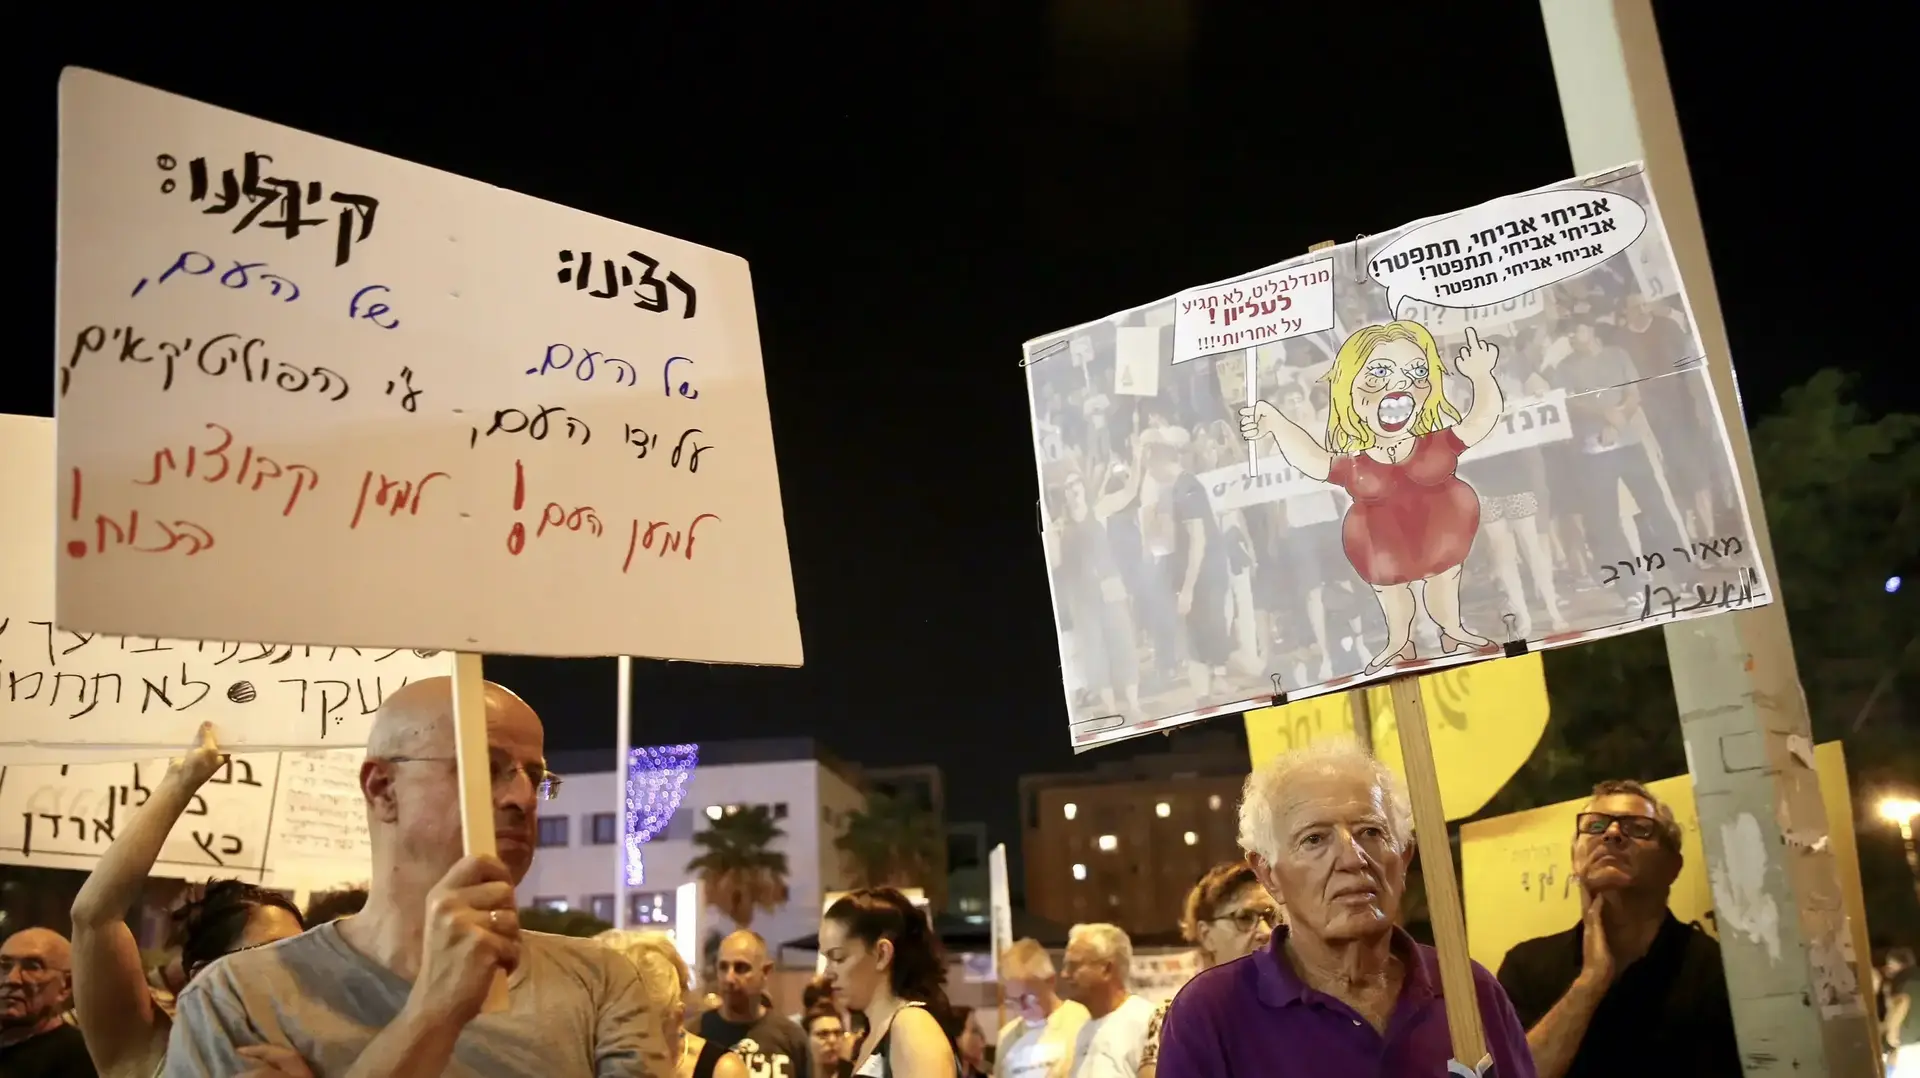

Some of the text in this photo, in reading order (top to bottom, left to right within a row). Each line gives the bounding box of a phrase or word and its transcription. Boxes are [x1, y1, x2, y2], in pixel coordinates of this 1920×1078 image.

[1372, 197, 1611, 277] אביחי אביחי, תתפטר!
[1419, 216, 1617, 280] אביחי אביחי, תתפטר!
[1182, 269, 1330, 314] מנדלבליט, לא תגיע
[1434, 243, 1604, 298] אביחי אביחי, תתפטר!
[349, 285, 401, 329] של
[1198, 317, 1302, 350] על אחריותי!!!
[665, 356, 698, 399] של
[672, 428, 714, 473] על
[132, 423, 451, 529] למען קבוצות
[623, 513, 721, 573] למען
[0, 671, 121, 719] תחמ
[141, 662, 211, 714] לא
